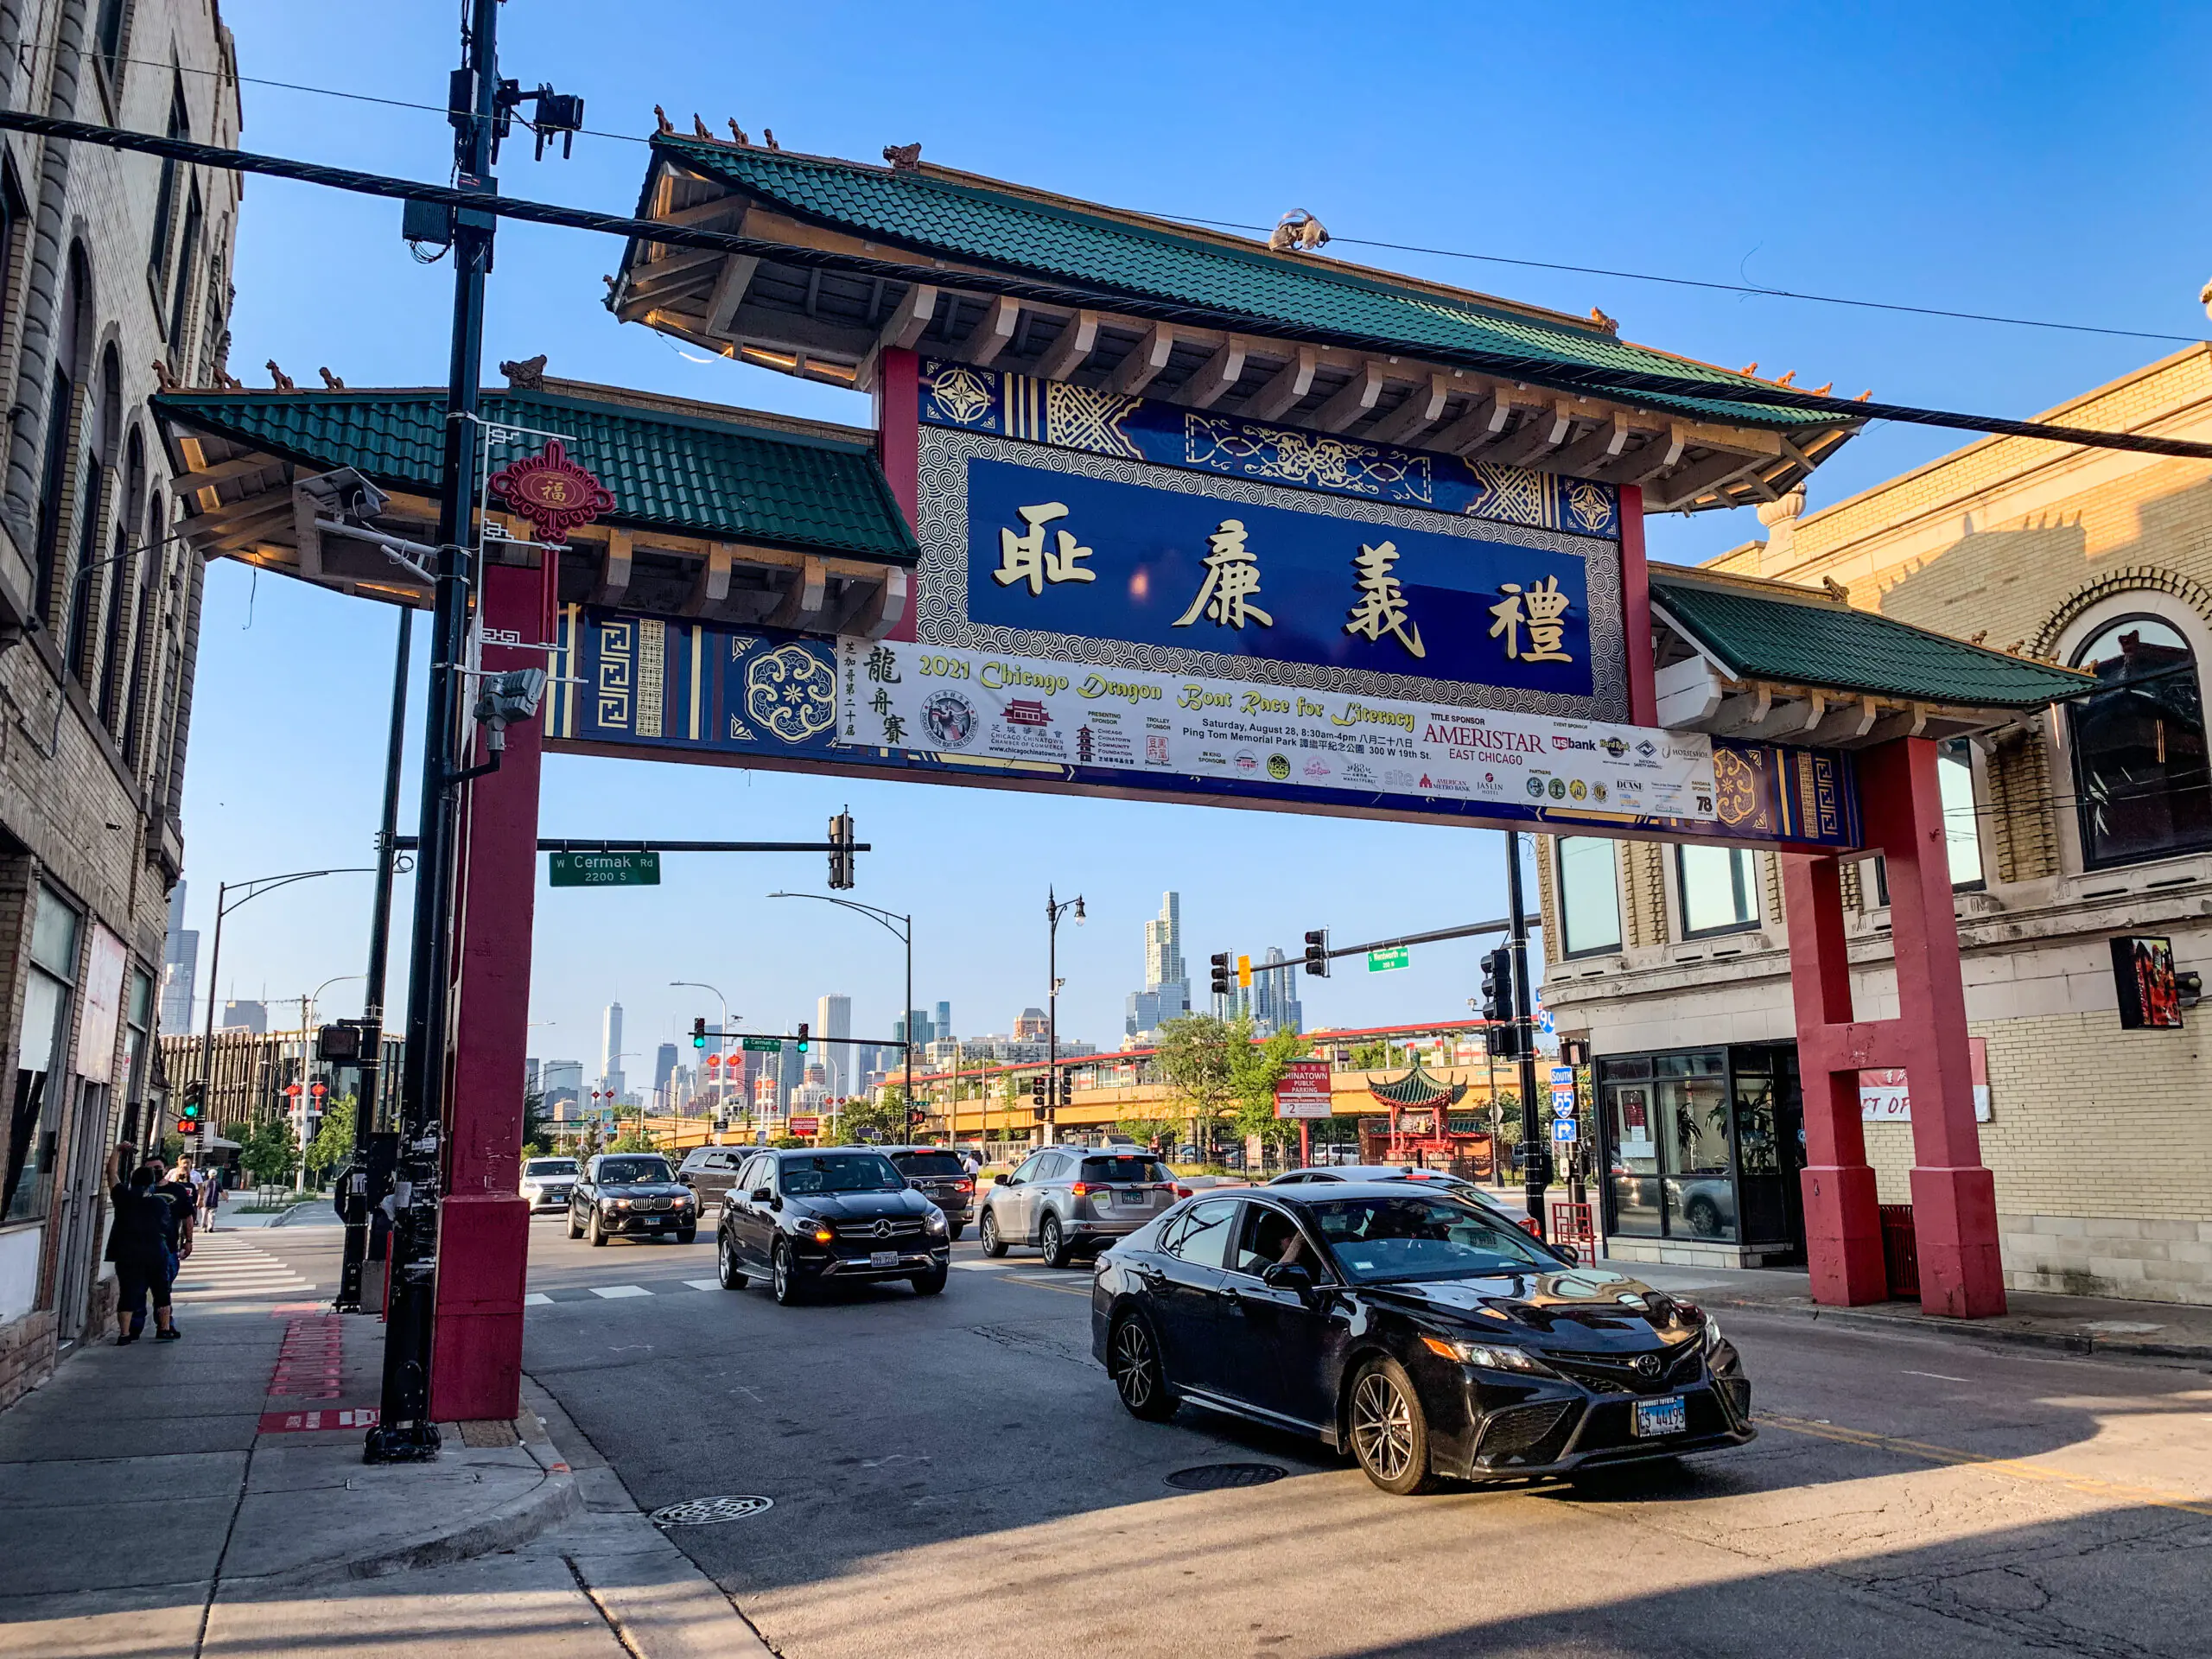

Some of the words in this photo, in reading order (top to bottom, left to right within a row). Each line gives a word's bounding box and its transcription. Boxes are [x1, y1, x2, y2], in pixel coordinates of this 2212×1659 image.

[540, 480, 566, 501] 福
[863, 645, 909, 745] 龍舟賽
[919, 655, 970, 680] 2021
[980, 661, 1070, 696] Chicago
[1077, 673, 1162, 705] Dragon
[1177, 684, 1232, 710] Boat
[1241, 690, 1289, 716] Race
[1296, 696, 1324, 717] for
[1331, 702, 1414, 733] Literacy
[1431, 713, 1450, 721] TITLE
[1451, 715, 1485, 726] SPONSOR
[990, 732, 1021, 741] CHICAGO
[1023, 735, 1064, 744] CHINATOWN
[1203, 719, 1247, 733] Saturday,
[1249, 723, 1282, 736] August
[1285, 727, 1298, 736] 28,
[1301, 728, 1357, 743] 8:30am-4pm
[1360, 734, 1413, 748] 八月二十八日
[1423, 724, 1547, 754] AMERISTAR
[988, 746, 1067, 759] www.chicagochinatown.org
[1183, 728, 1205, 740] Ping
[1207, 730, 1228, 741] Tom
[1230, 733, 1273, 744] Memorial
[1276, 736, 1297, 747] Park
[1369, 746, 1384, 755] 300
[1387, 747, 1396, 756] W
[1398, 748, 1418, 758] 19th
[1420, 751, 1432, 760] St.
[1600, 740, 1616, 749] Hard
[1617, 741, 1630, 751] Rock
[1449, 748, 1475, 760] EAST
[1478, 752, 1523, 766] CHICAGO
[1384, 769, 1414, 787] site
[1477, 782, 1503, 791] JASLIN
[1696, 796, 1713, 812] 78
[556, 860, 565, 868] W
[575, 855, 632, 868] Cermak
[640, 859, 653, 868] Rd
[585, 873, 614, 881] 2200
[1552, 1071, 1571, 1082] SOUTH
[1554, 1092, 1572, 1111] 55
[1639, 1412, 1650, 1428] CS
[1656, 1407, 1684, 1426] 44195
